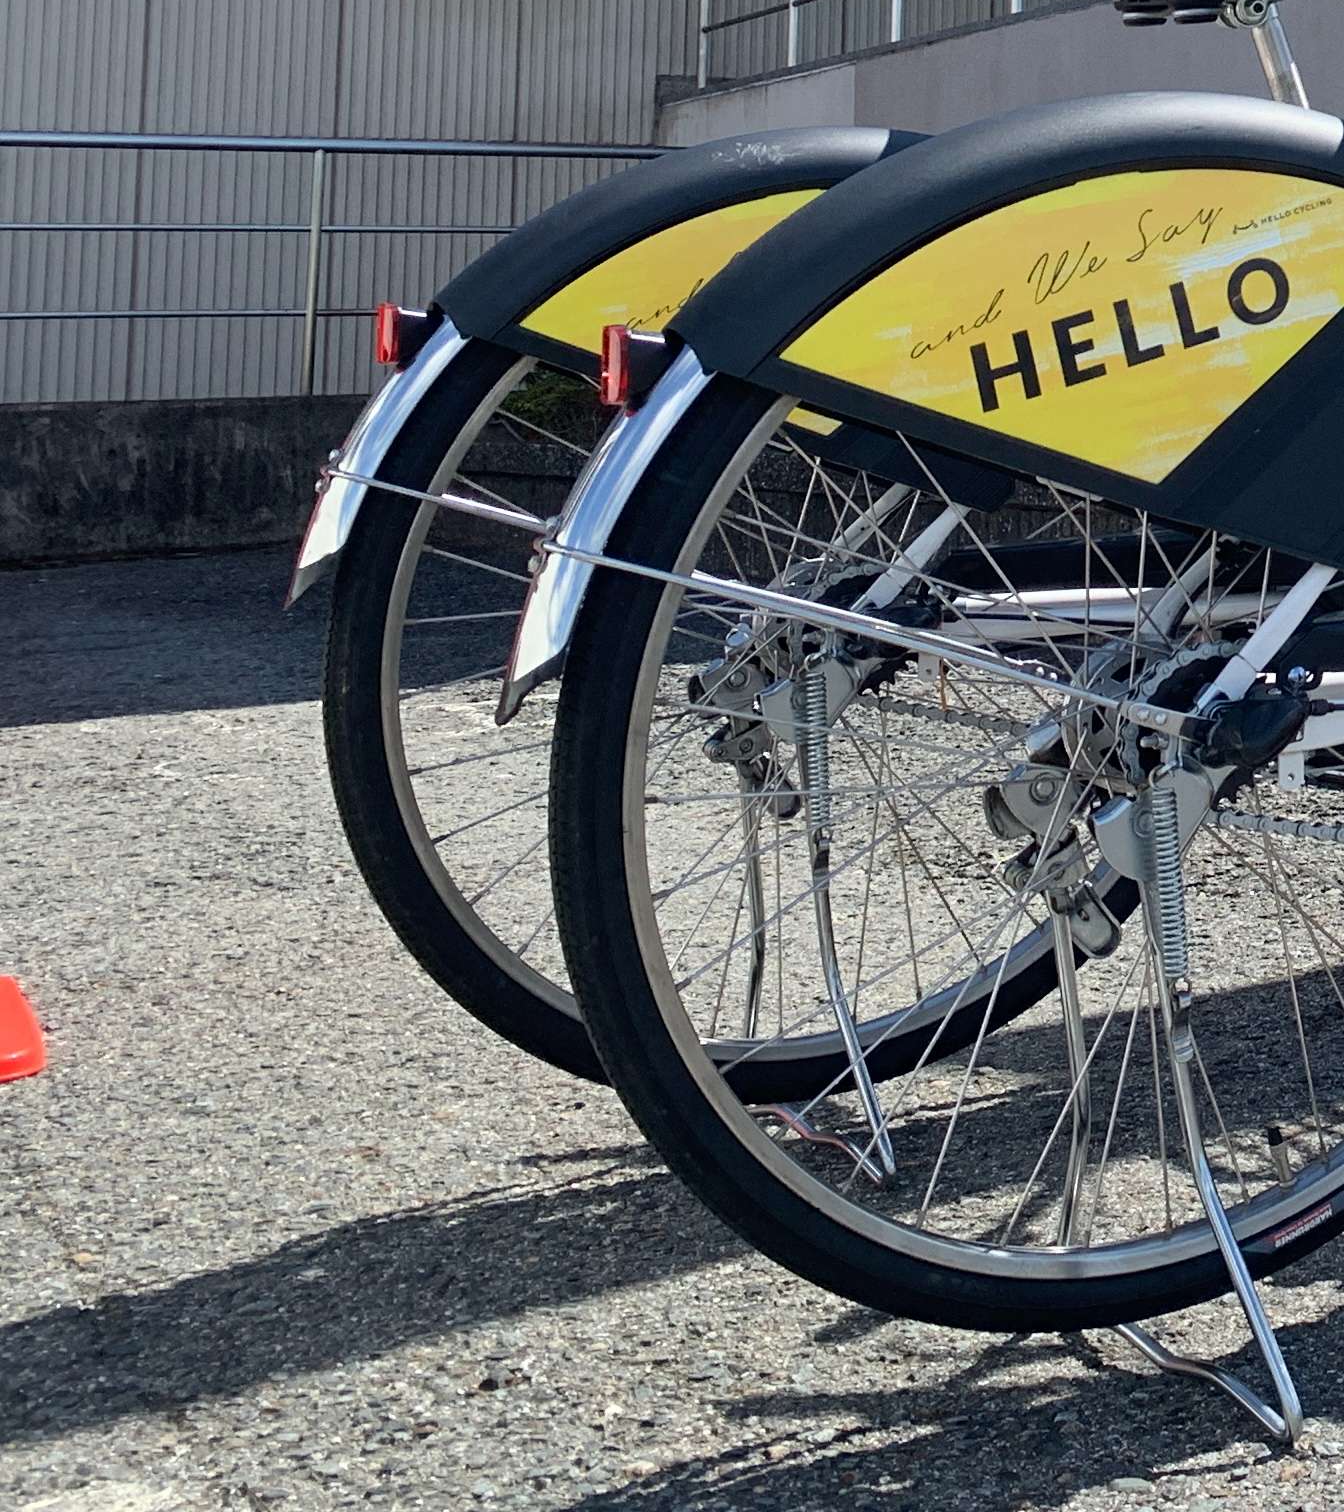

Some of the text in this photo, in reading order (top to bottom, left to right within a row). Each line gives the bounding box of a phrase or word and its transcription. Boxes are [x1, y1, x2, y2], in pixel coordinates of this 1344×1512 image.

[909, 206, 1224, 360] and We Say
[1261, 197, 1333, 225] HELLO CYCLING
[969, 256, 1291, 414] HELLO
